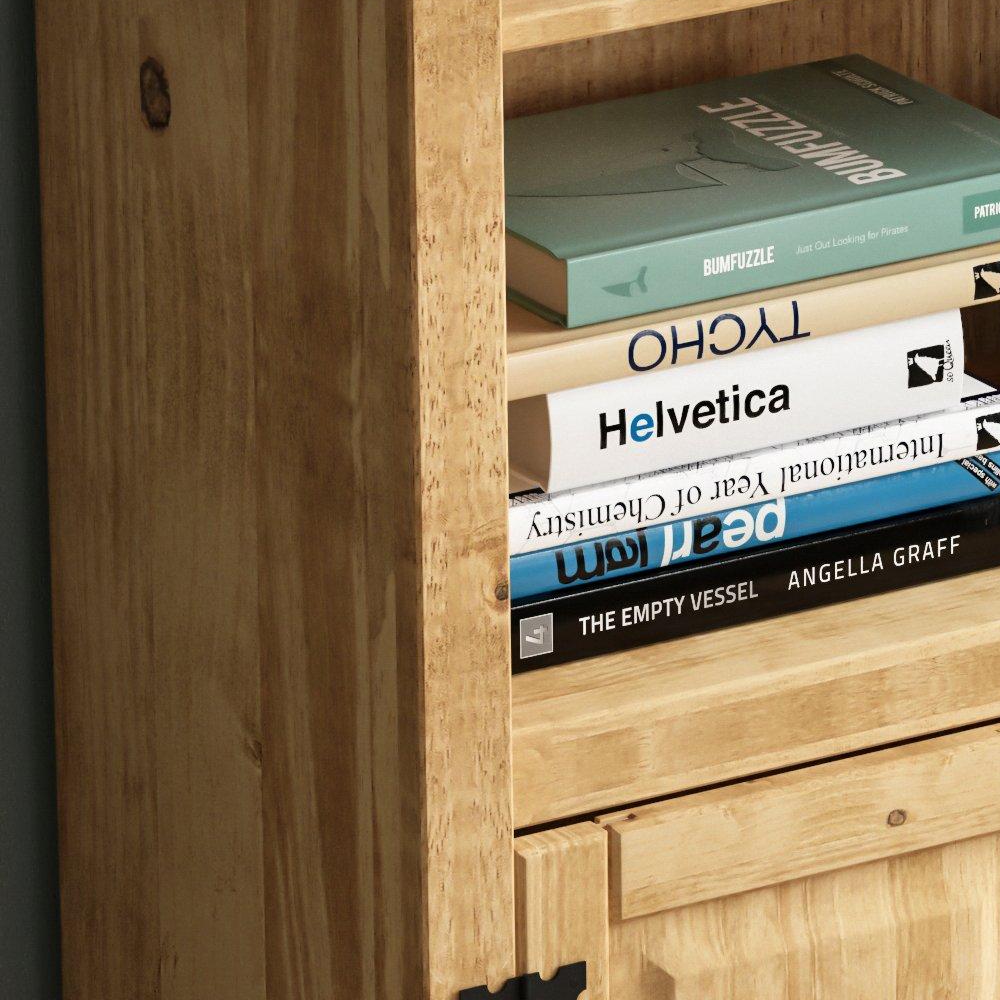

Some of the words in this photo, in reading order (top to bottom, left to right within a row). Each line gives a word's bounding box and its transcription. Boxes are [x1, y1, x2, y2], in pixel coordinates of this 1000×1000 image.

[697, 97, 907, 185] BUMFUZZLE
[703, 245, 775, 277] BUMFUZZLE
[795, 243, 813, 255] Just
[814, 240, 831, 251] Out
[832, 232, 866, 247] Looking
[867, 230, 879, 241] for
[881, 224, 909, 237] Pirates
[628, 300, 811, 372] TYCHO
[599, 384, 791, 450] Helvetica
[710, 472, 769, 499] Year
[781, 433, 945, 493] International
[961, 458, 986, 479] special
[526, 493, 666, 541] Chemistry
[671, 485, 702, 518] of
[661, 497, 787, 568] pearl
[579, 610, 616, 636] THE
[621, 595, 686, 627] EMPTY
[690, 580, 759, 612] VESSEL
[788, 552, 884, 591] ANGELLA
[893, 535, 962, 568] GRAFF
